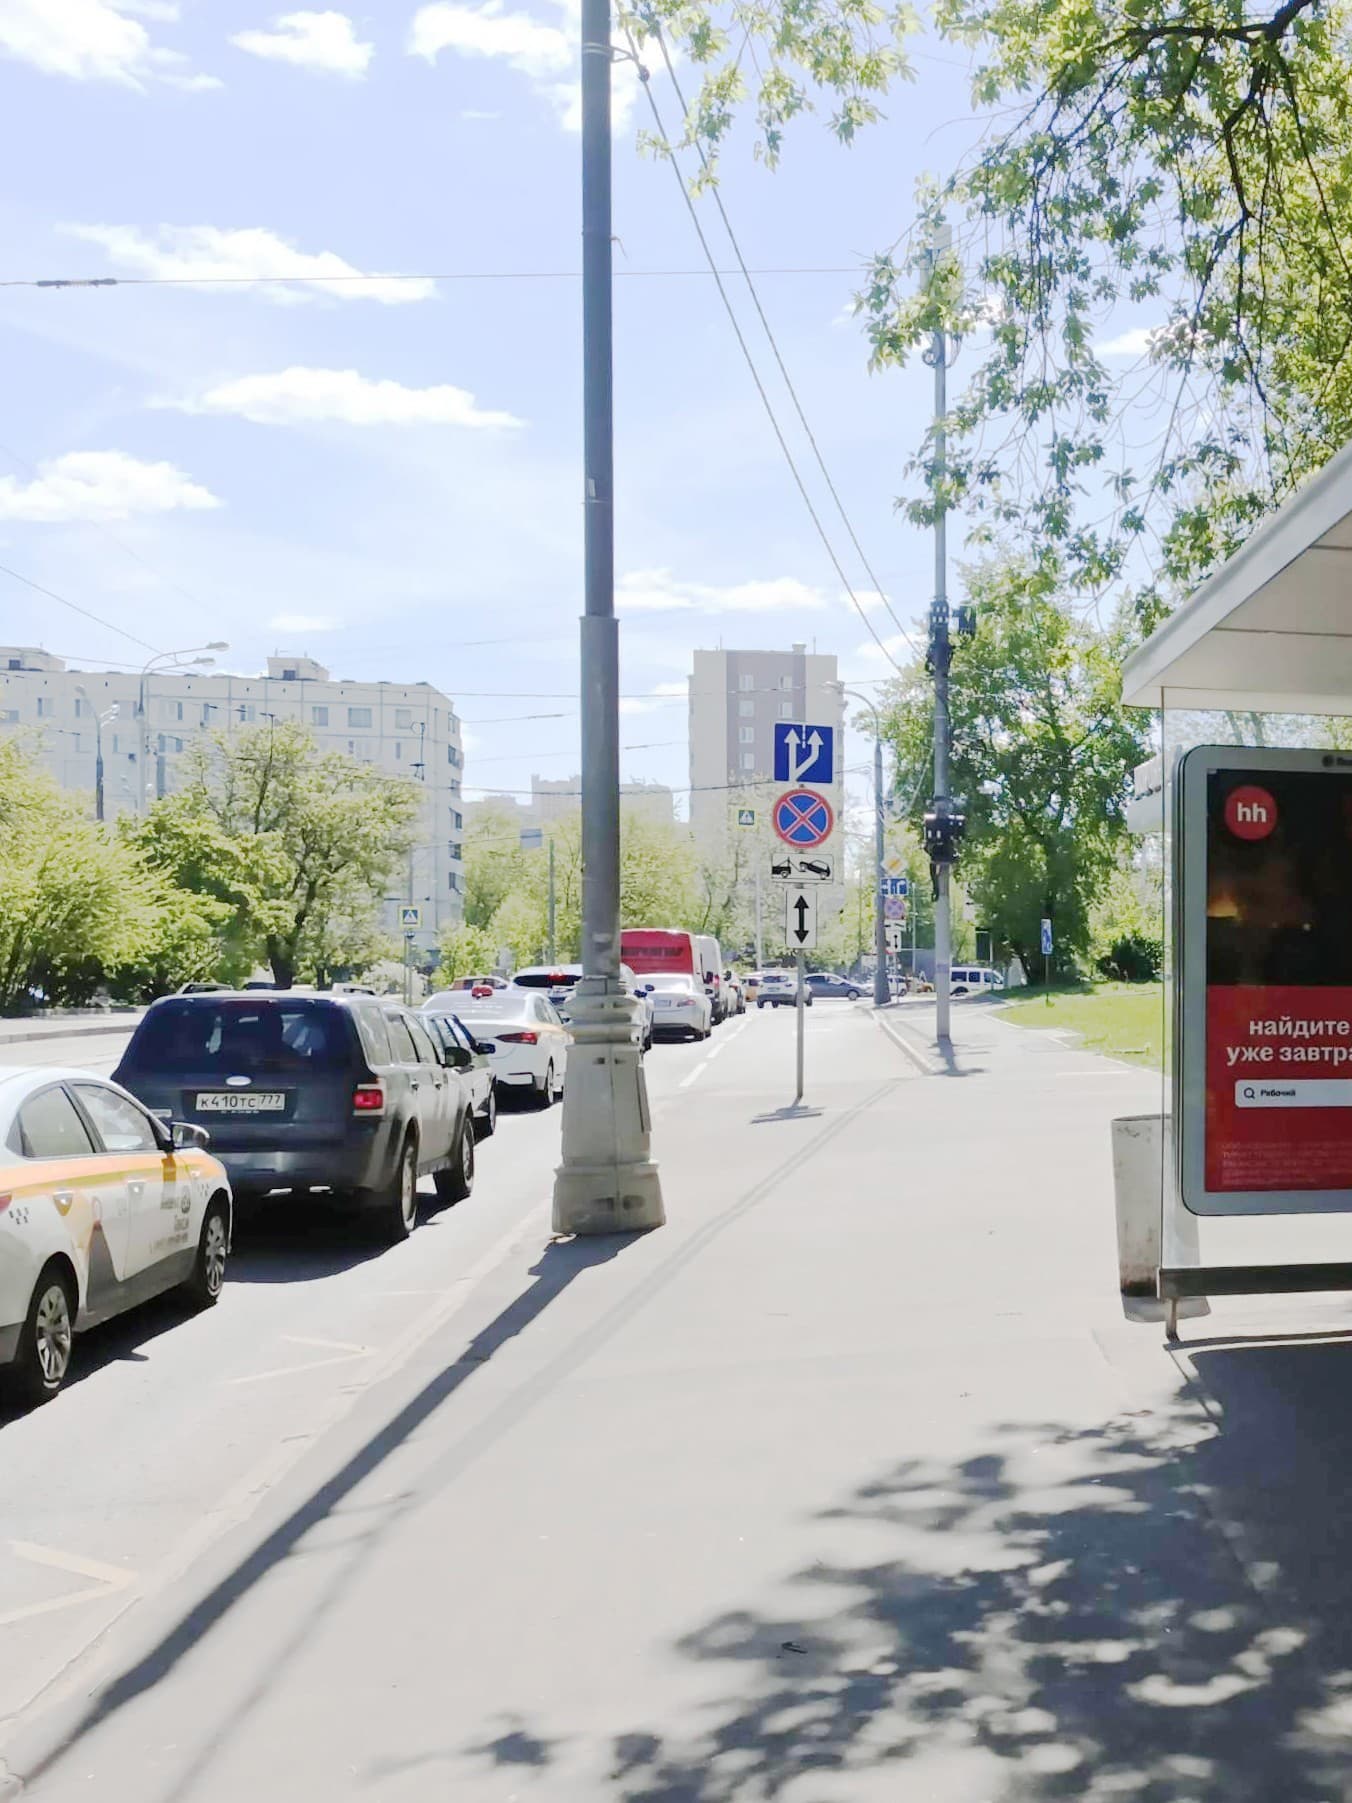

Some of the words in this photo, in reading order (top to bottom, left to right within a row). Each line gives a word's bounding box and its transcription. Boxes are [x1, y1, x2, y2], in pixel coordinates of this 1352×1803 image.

[1237, 802, 1267, 822] hh
[1249, 1016, 1350, 1039] найдите
[1226, 1045, 1274, 1066] уже
